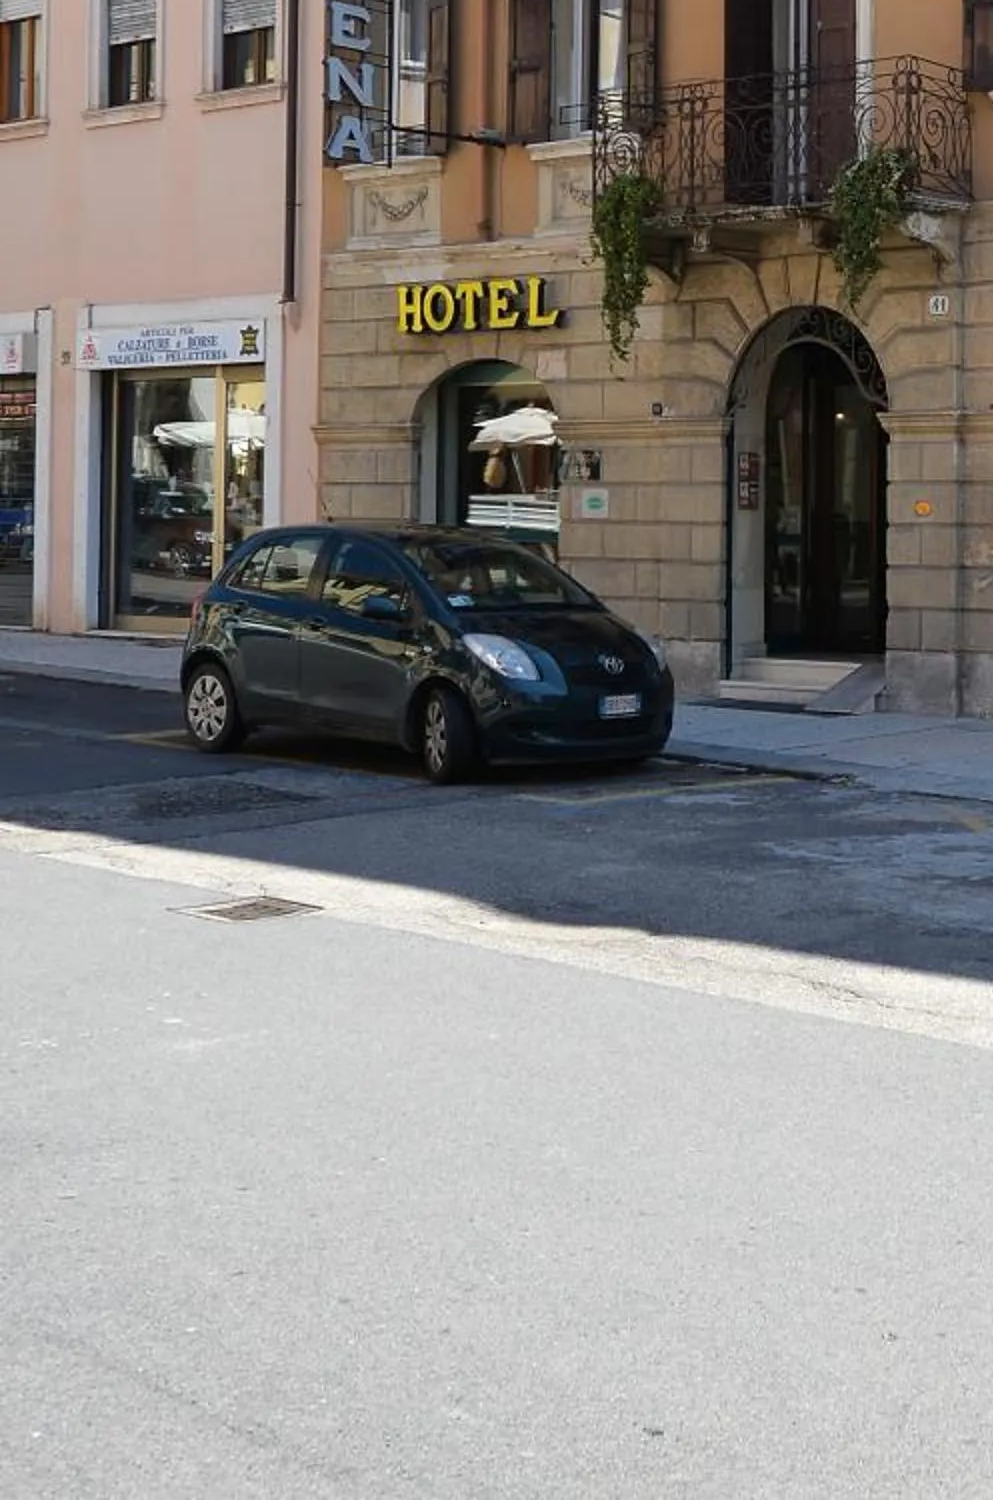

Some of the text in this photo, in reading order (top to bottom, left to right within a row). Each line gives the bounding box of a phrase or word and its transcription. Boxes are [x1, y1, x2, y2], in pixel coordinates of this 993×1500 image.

[397, 274, 560, 333] HOTEL
[117, 337, 170, 352] CALZATURE
[187, 335, 219, 350] BORSE
[165, 350, 229, 364] PELLETTERIA
